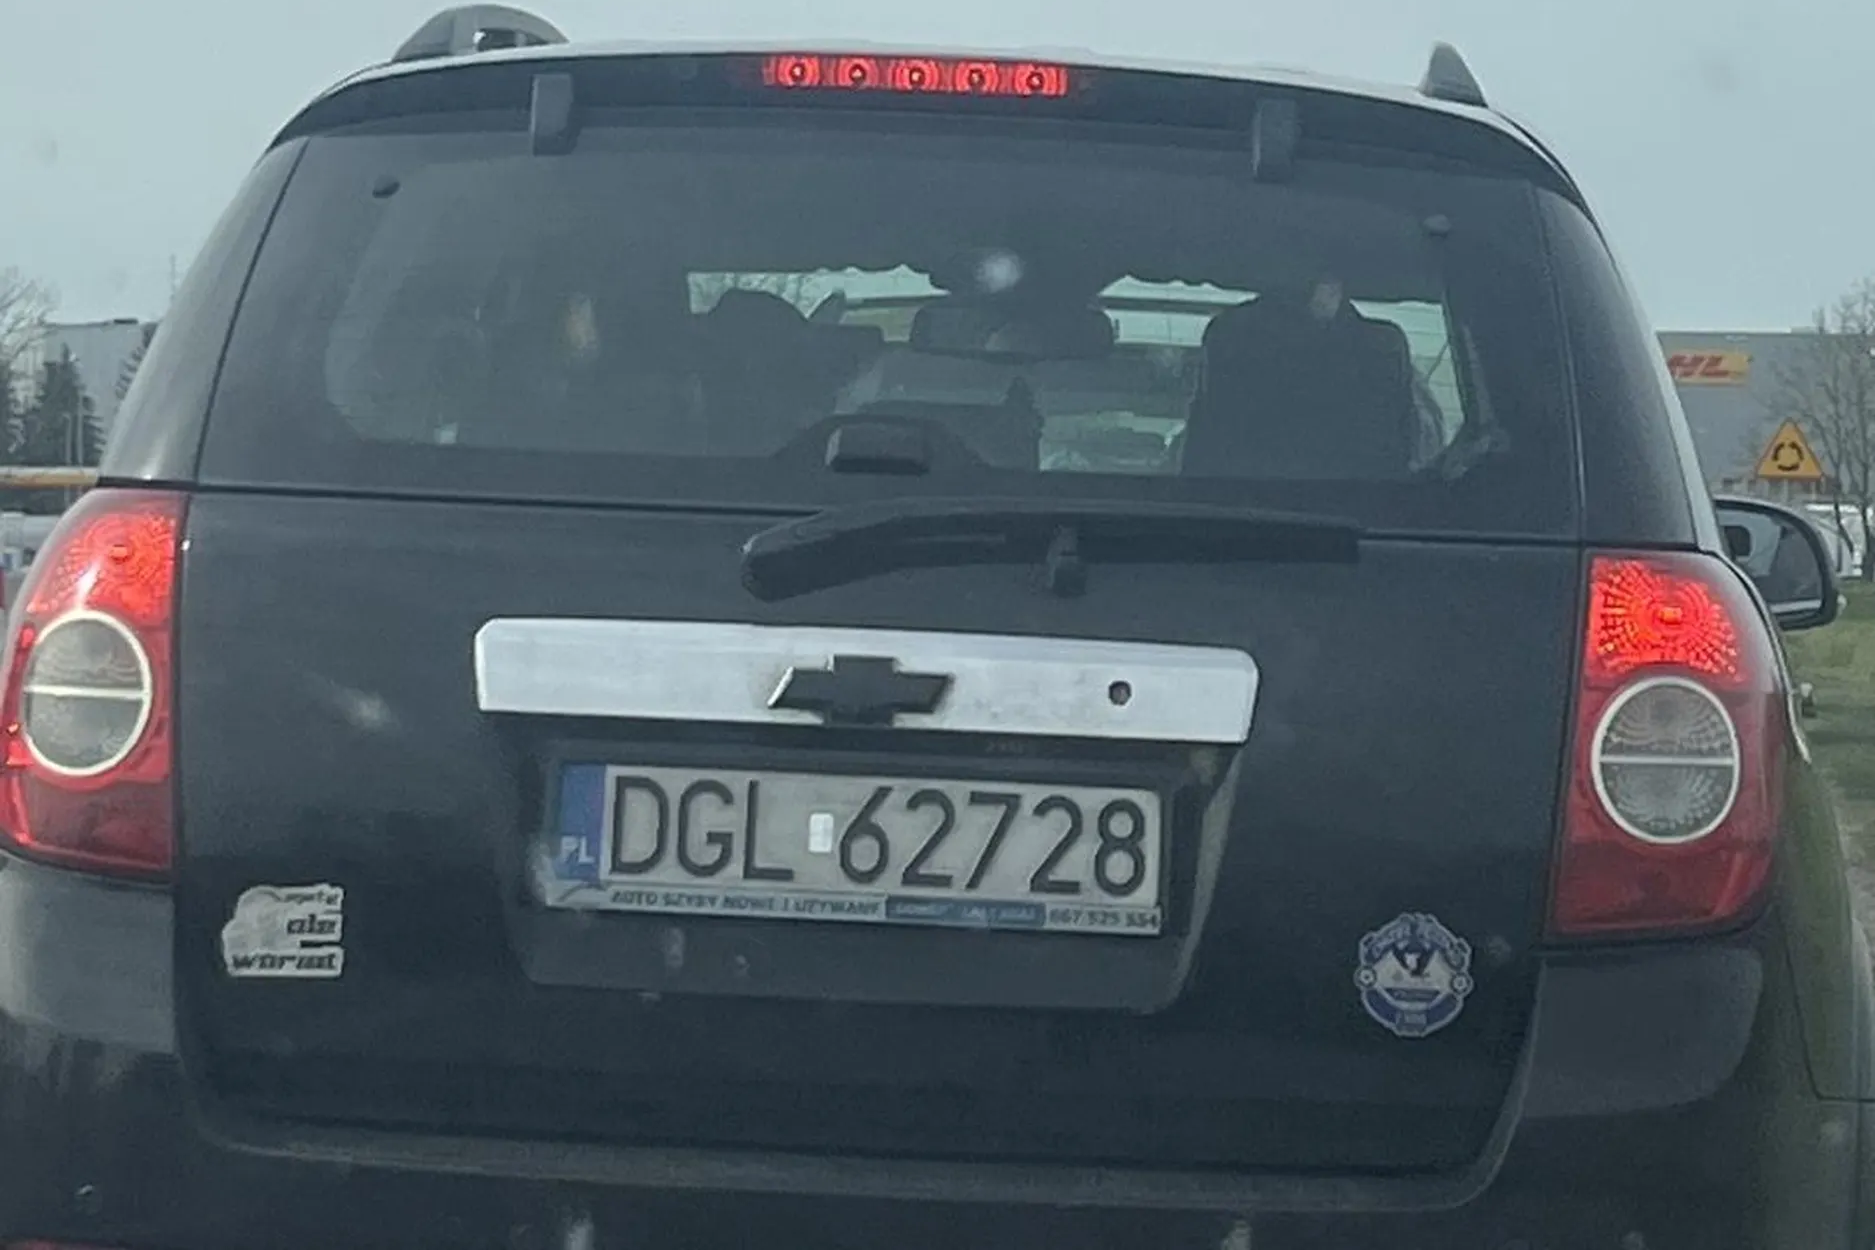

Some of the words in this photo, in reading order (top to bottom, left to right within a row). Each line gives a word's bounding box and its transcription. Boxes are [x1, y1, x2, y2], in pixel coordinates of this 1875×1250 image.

[560, 835, 595, 864] PL
[610, 775, 795, 881] DGL
[838, 785, 1146, 897] 62728
[611, 890, 659, 906] AUTO
